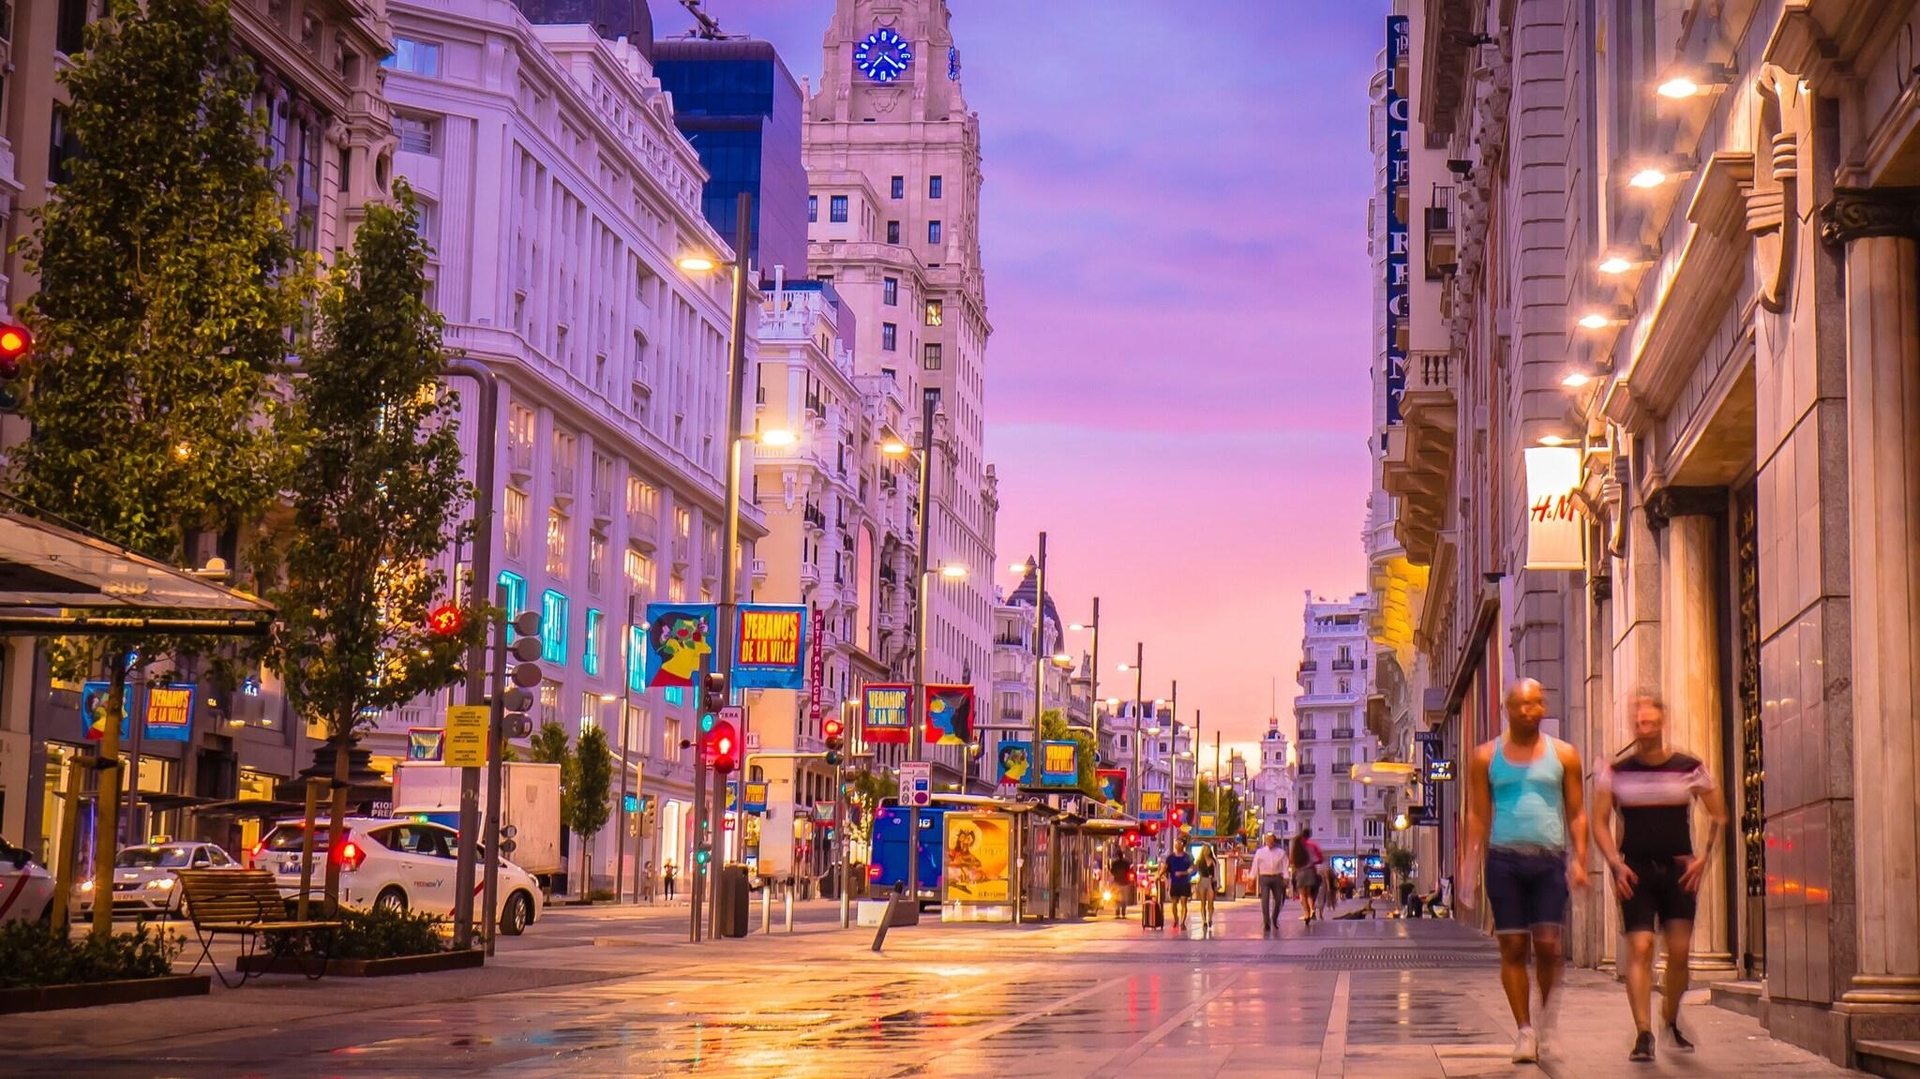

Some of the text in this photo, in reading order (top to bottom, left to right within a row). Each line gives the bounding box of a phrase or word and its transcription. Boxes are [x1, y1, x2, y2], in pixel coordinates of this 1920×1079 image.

[1531, 494, 1576, 523] H&M
[744, 613, 798, 641] VERANOS
[742, 641, 796, 663] DE LA VILLA
[151, 689, 190, 708] VERANOS
[868, 690, 906, 709] VERANOS
[148, 707, 157, 722] DE
[158, 707, 168, 722] LA
